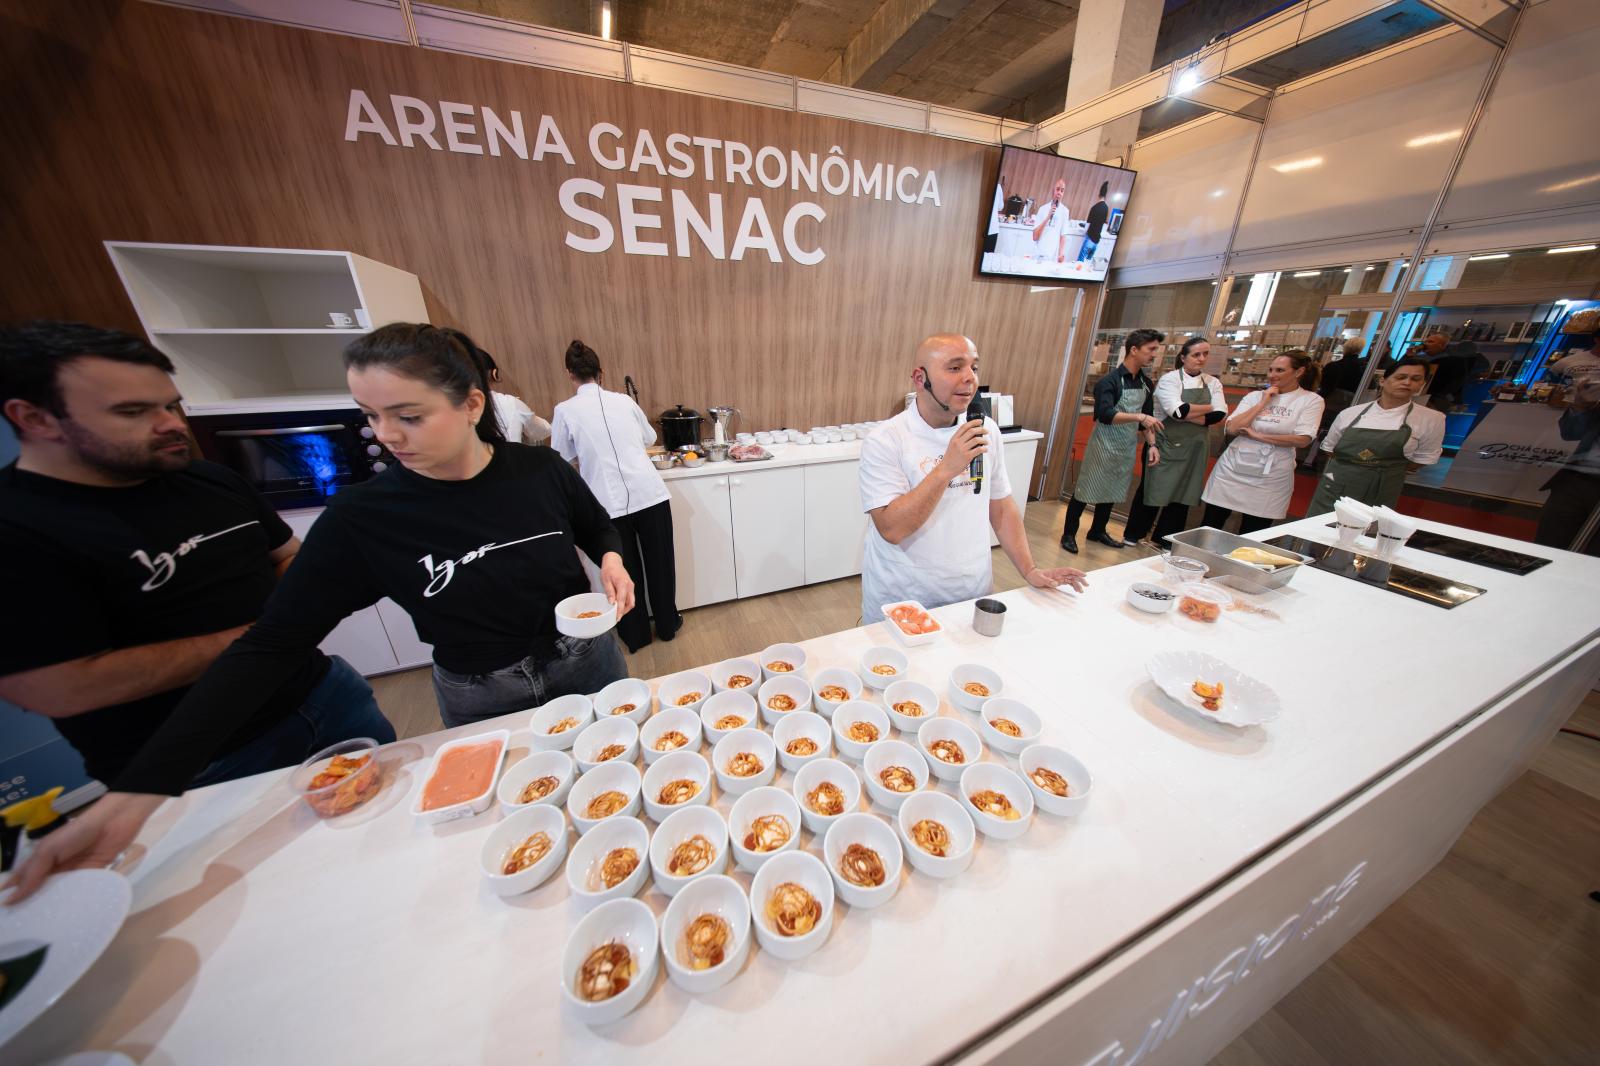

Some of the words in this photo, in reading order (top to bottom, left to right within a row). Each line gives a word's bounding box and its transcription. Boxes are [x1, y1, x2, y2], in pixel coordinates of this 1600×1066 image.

[344, 88, 576, 166] ARENA
[588, 121, 942, 208] GASTRONÔMICA
[558, 177, 828, 266] SENAC
[129, 520, 261, 592] Igor
[417, 531, 564, 598] Igor
